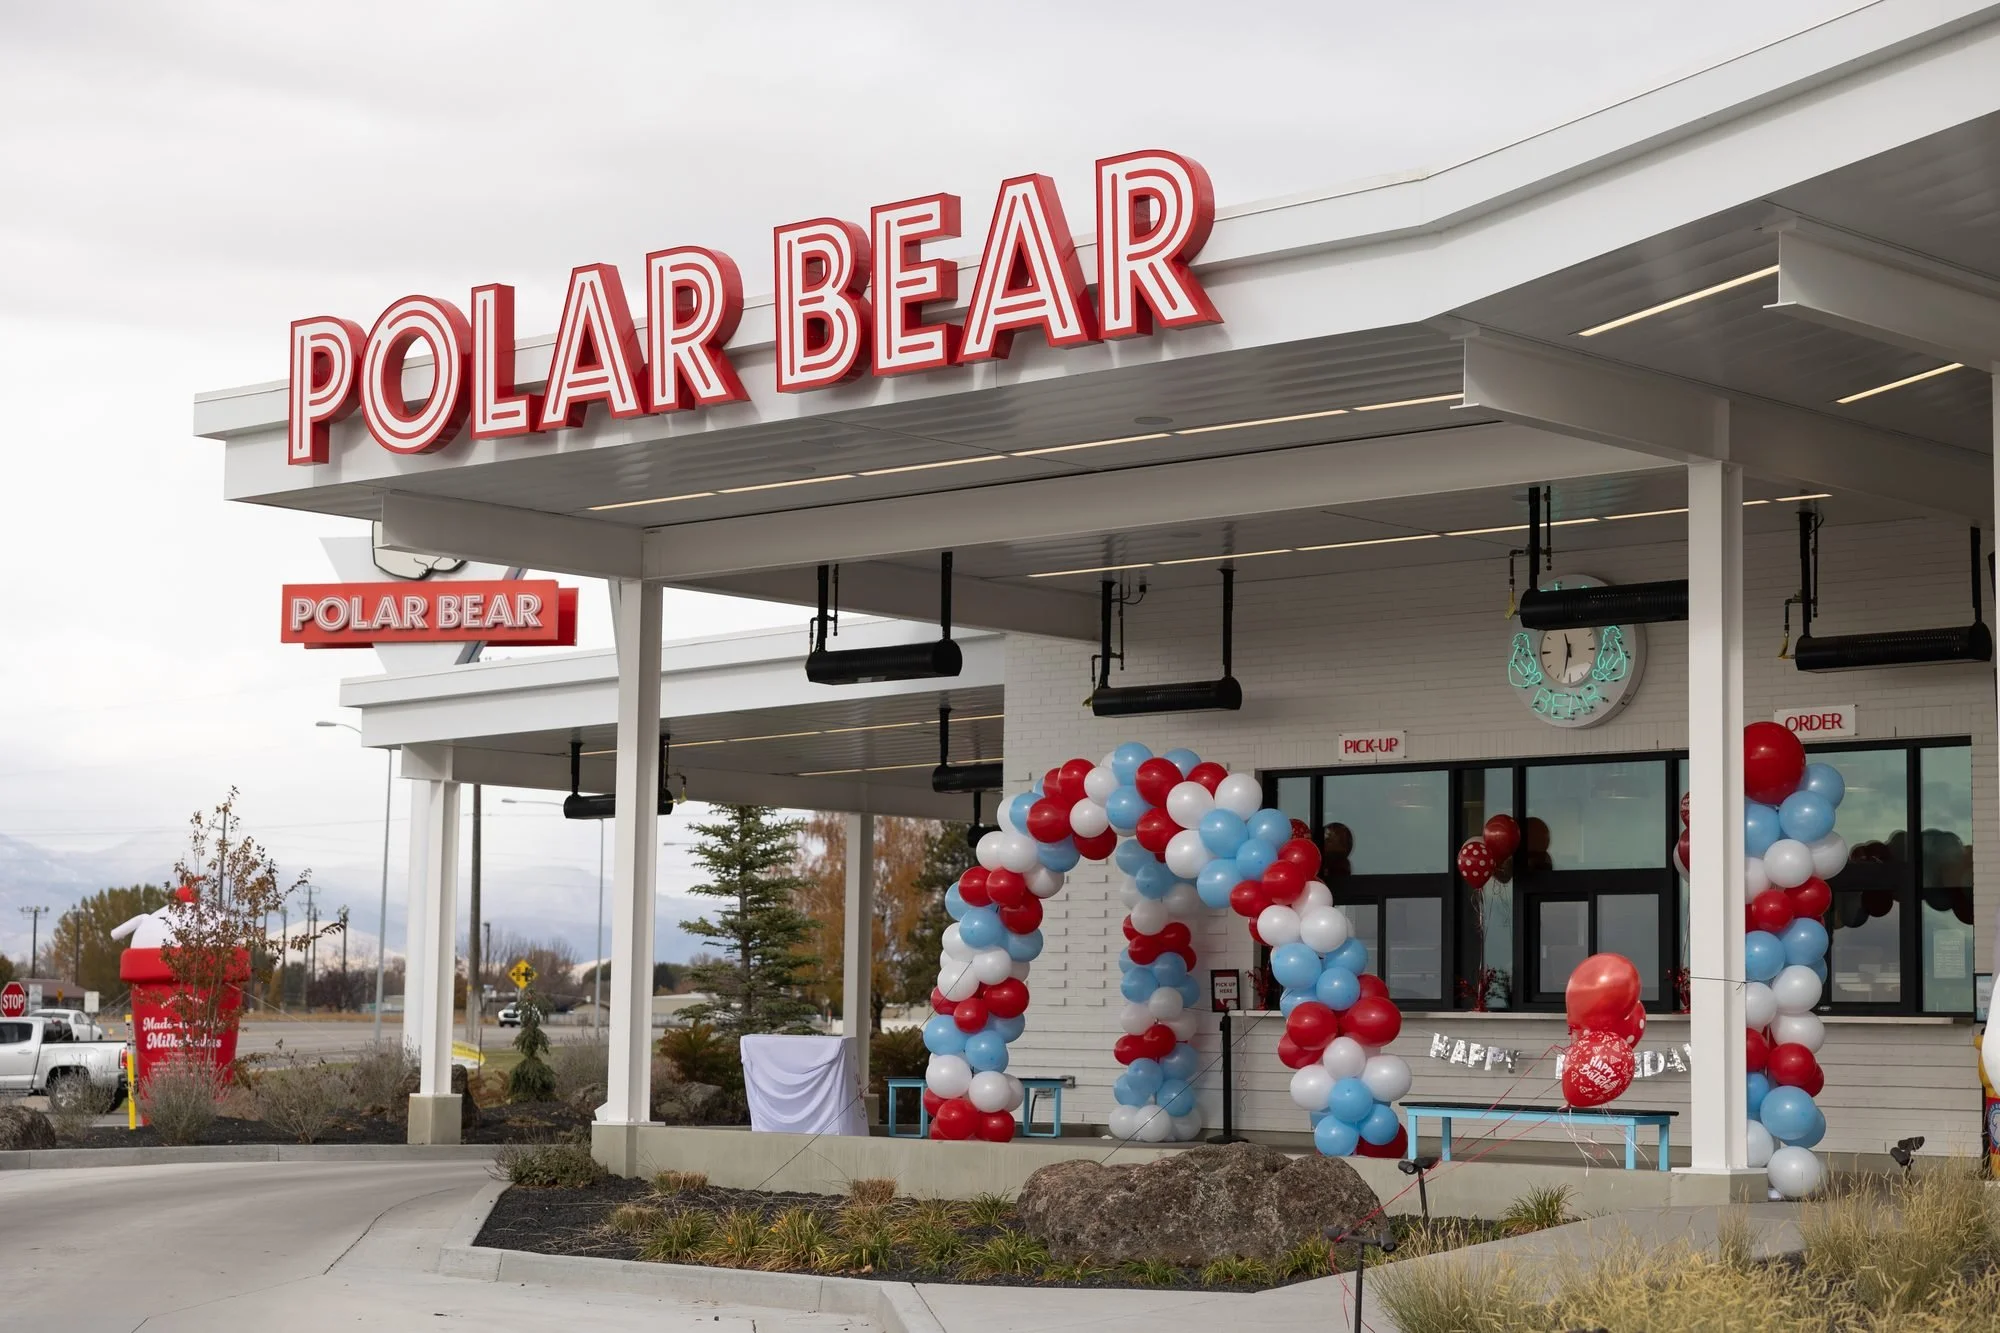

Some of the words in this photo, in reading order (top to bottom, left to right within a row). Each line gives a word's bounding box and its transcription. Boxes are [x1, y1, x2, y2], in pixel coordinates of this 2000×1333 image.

[288, 245, 750, 466] POLAR
[773, 149, 1224, 394] BEAR
[290, 594, 429, 632] POLAR
[437, 593, 543, 629] BEAR
[1532, 684, 1608, 719] BEAR
[1785, 713, 1844, 732] ORDER
[1344, 737, 1399, 754] PICK-UP
[2, 994, 24, 1010] STOP
[1429, 1032, 1521, 1074] HAPPY
[1590, 1054, 1617, 1079] HAPPY
